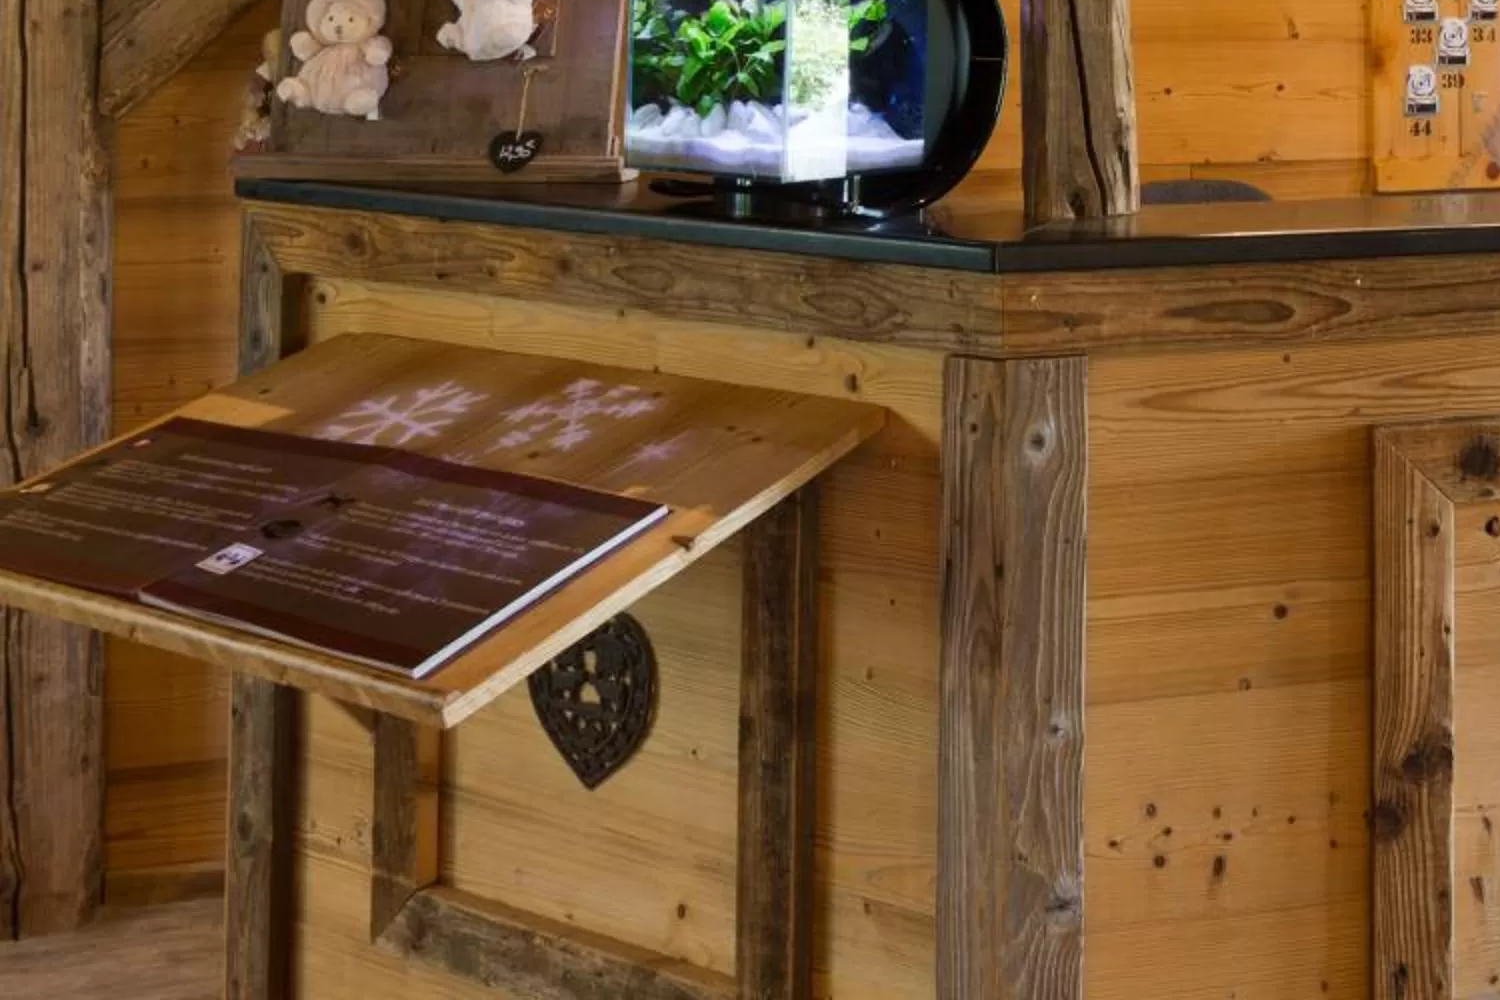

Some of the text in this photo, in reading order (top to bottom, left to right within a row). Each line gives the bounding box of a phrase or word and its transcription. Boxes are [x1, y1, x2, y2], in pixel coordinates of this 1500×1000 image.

[1410, 26, 1496, 45] 33 34
[1441, 71, 1465, 89] 39
[1408, 120, 1433, 136] 44
